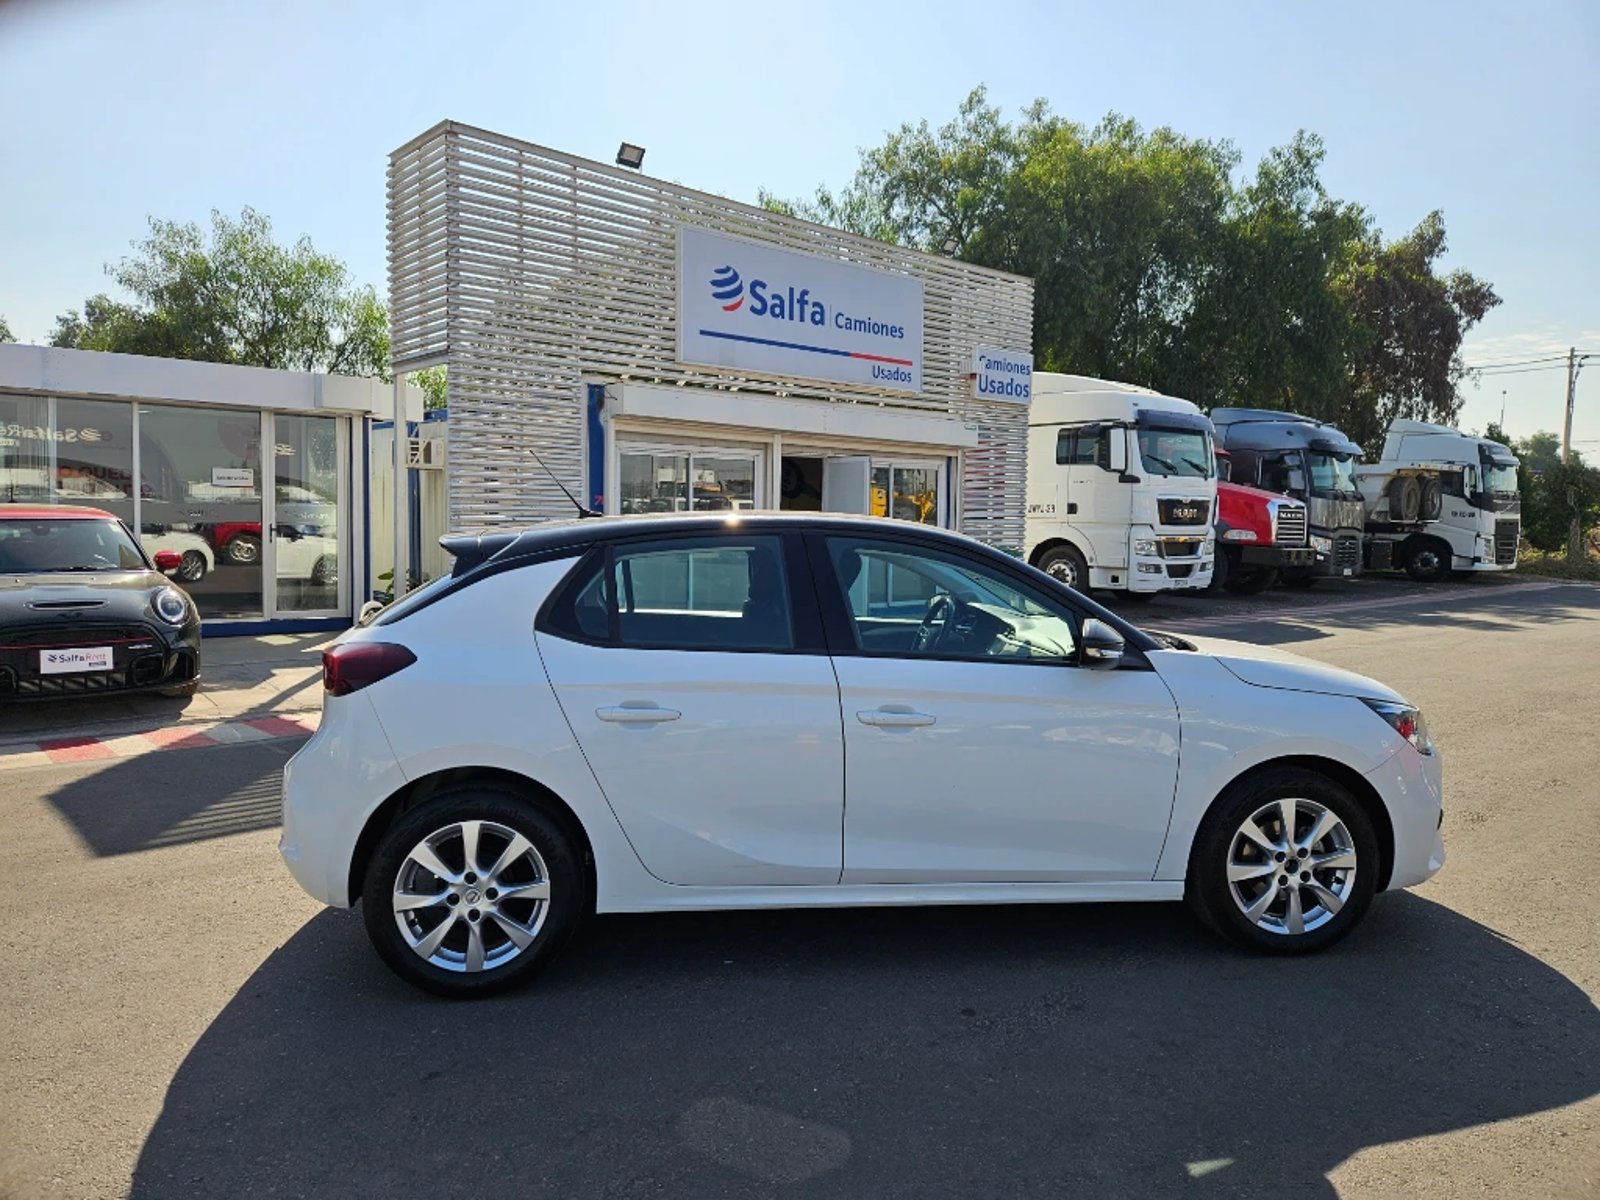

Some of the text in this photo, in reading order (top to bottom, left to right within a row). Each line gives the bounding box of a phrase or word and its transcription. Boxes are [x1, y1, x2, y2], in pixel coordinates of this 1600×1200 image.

[749, 279, 905, 339] Salfa Camiones
[872, 365, 912, 383] Usados
[979, 373, 1029, 398] Usados
